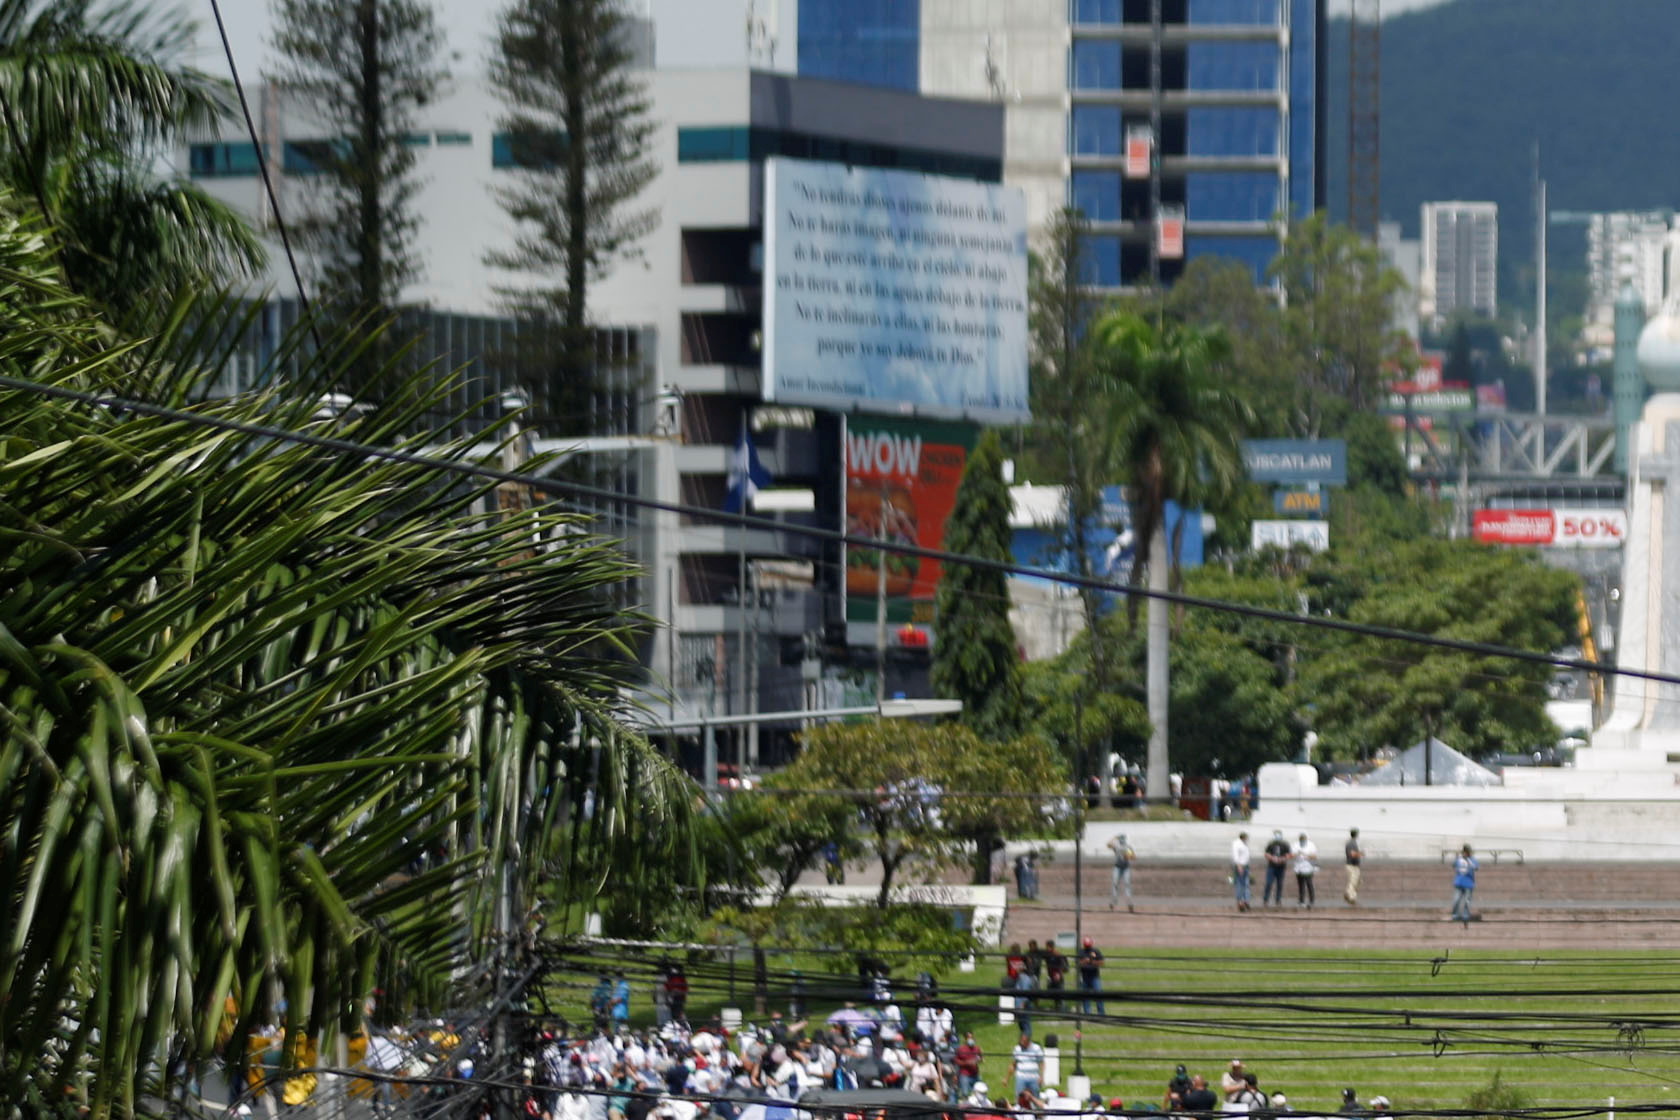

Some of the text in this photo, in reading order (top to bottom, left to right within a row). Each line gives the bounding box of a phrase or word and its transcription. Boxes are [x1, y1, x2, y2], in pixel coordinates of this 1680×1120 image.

[824, 250, 845, 267] que
[979, 264, 1007, 283] abajo
[847, 430, 922, 478] WOW
[1244, 453, 1333, 471] USCATLAN
[1283, 492, 1322, 510] ATM
[1564, 516, 1622, 537] 50%
